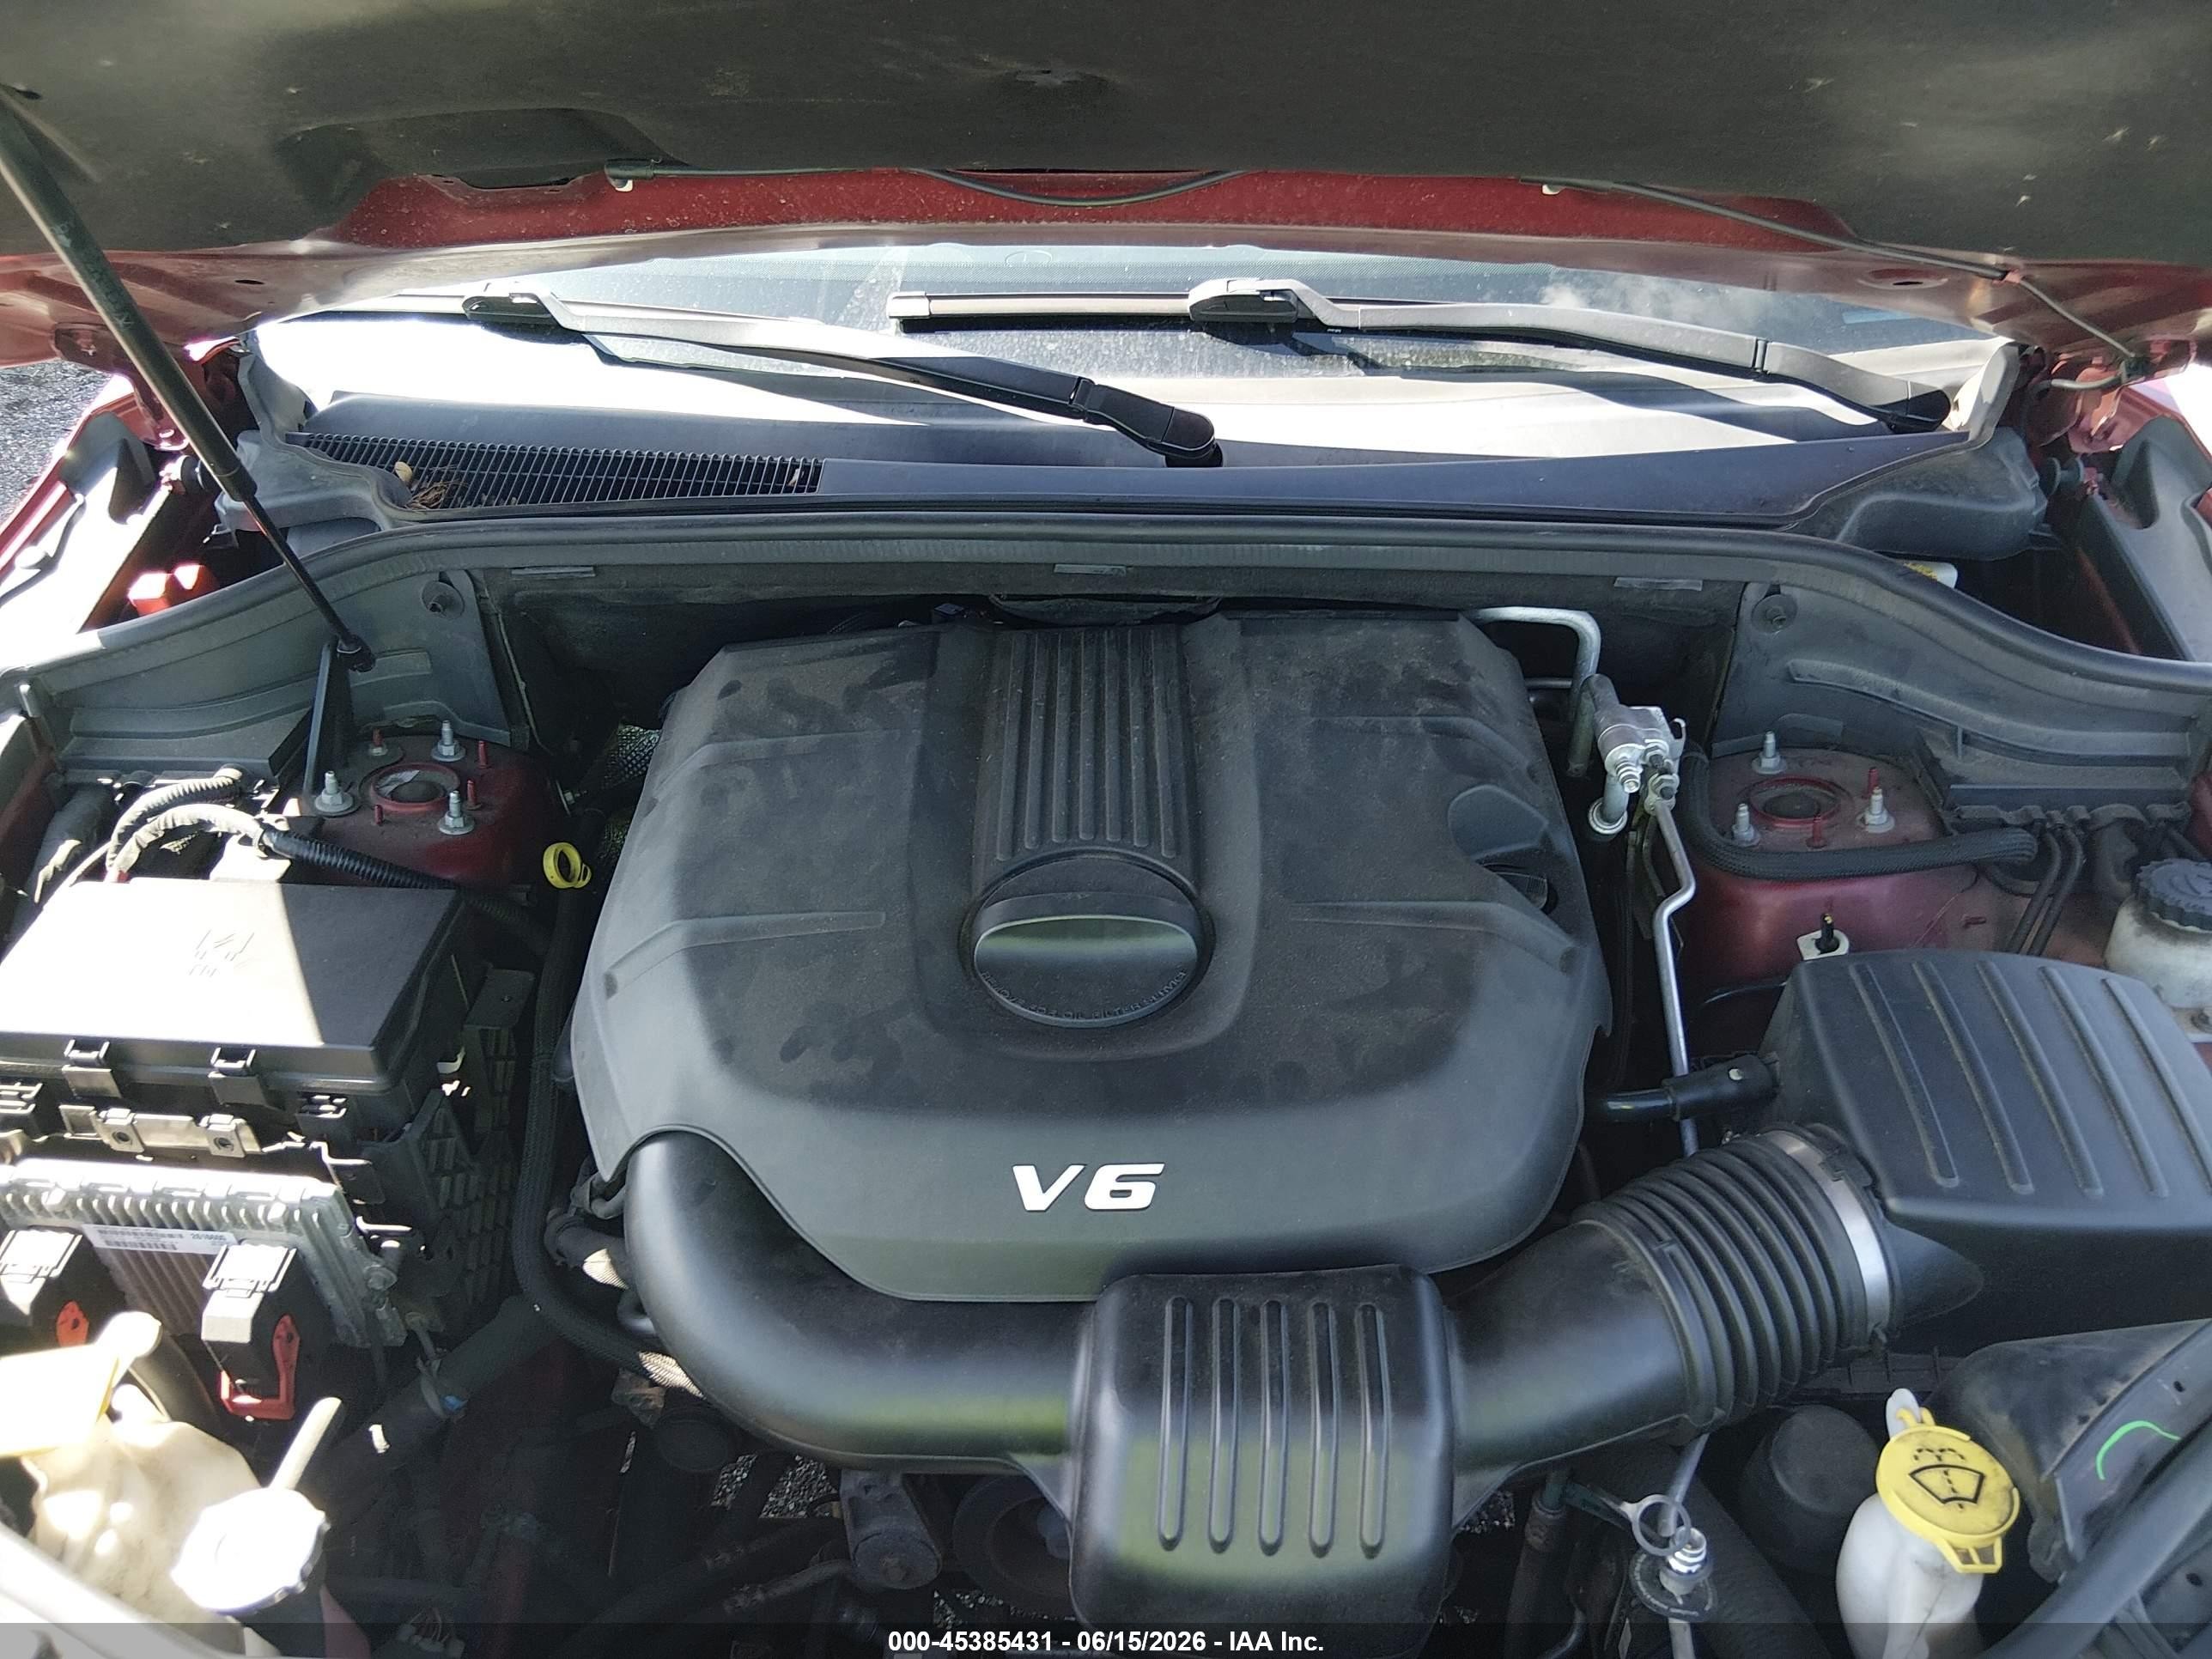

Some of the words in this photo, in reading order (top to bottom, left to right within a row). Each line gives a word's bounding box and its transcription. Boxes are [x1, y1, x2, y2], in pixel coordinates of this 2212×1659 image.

[981, 969, 1025, 1006] REMOVE
[1028, 1003, 1058, 1017] FOR
[1063, 1009, 1085, 1020] OIL
[1091, 1001, 1141, 1019] FILTER
[1142, 965, 1188, 1003] SERVICE
[1012, 1164, 1165, 1212] V6
